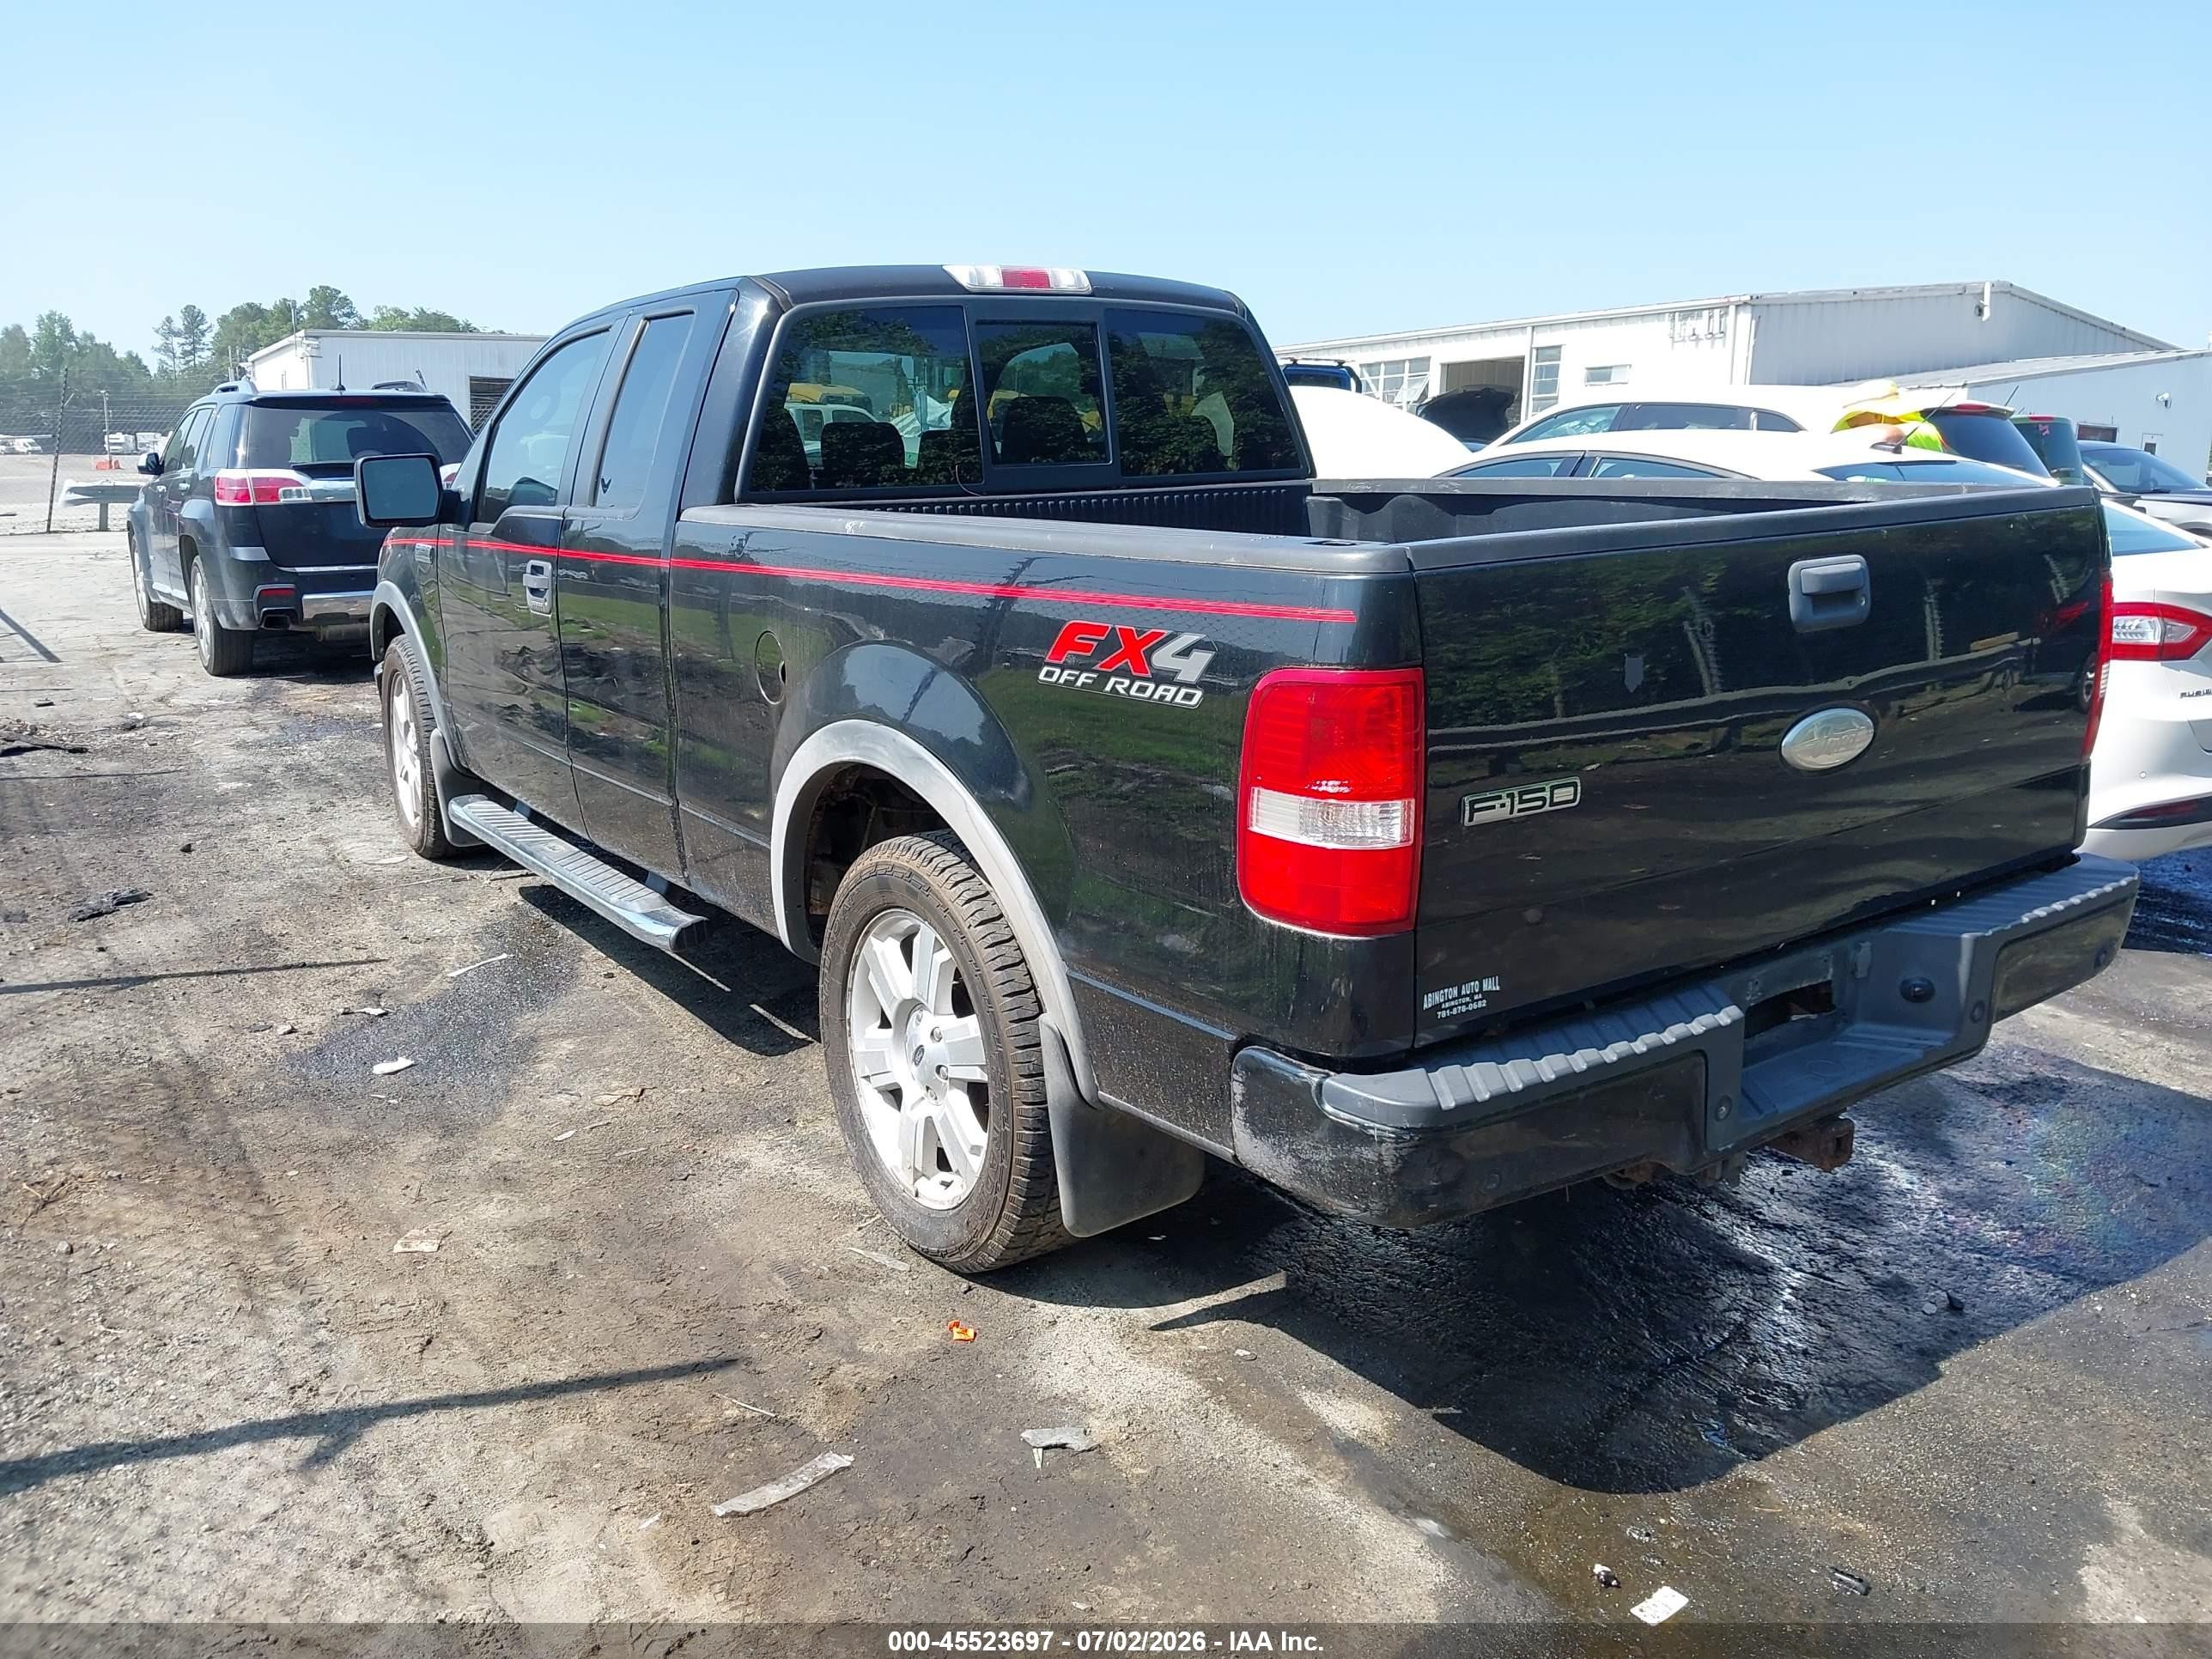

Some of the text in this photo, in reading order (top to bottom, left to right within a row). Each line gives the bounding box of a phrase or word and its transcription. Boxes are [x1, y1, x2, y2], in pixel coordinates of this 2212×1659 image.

[1044, 619, 1218, 684] FX4
[1037, 666, 1205, 707] OFF ROAD
[1465, 779, 1580, 824] F-150
[1423, 975, 1500, 1010] ABINGTON AUTO MALL
